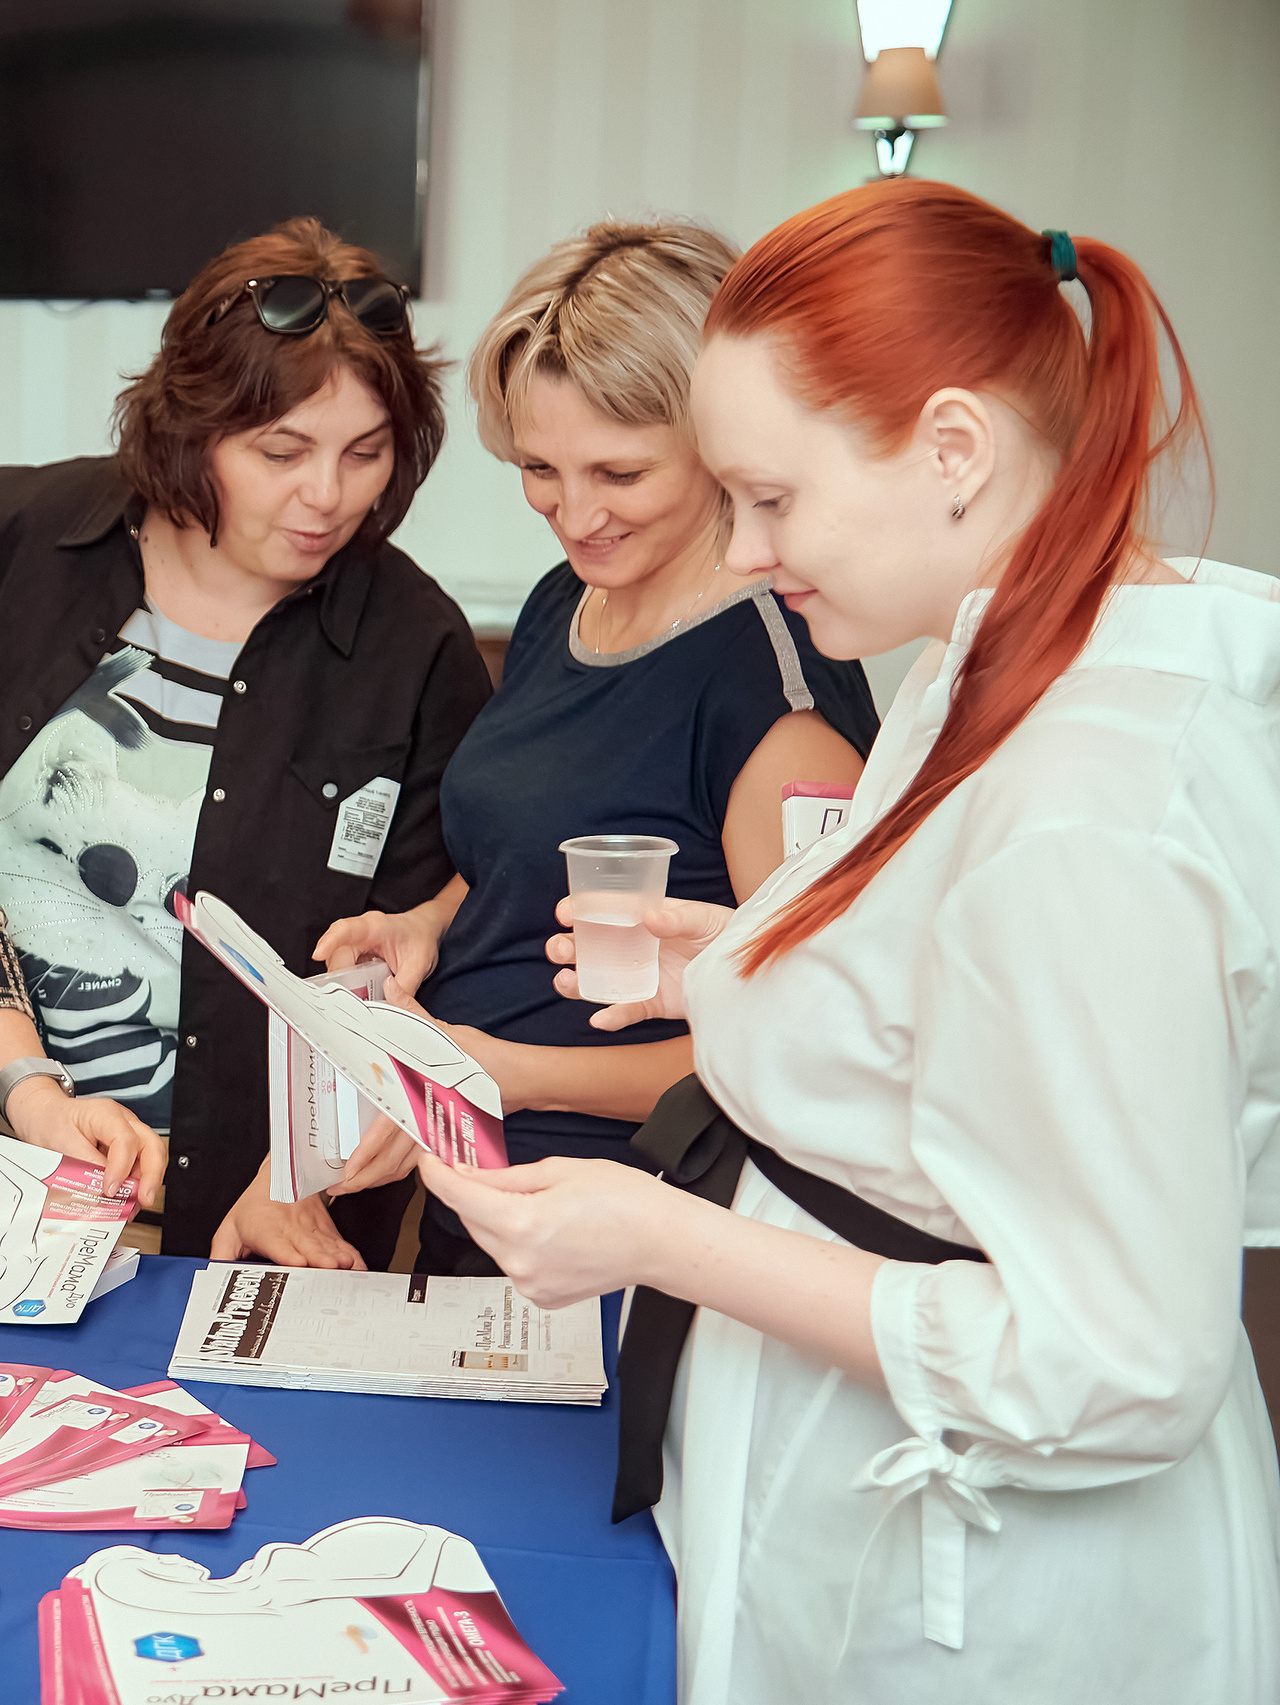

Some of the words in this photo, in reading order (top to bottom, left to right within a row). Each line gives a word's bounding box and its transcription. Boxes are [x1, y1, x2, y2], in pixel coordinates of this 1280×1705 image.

[60, 1228, 109, 1294] ПреМама
[65, 1291, 86, 1309] Дуо
[453, 1611, 487, 1648] ОМЕГА-3
[201, 1677, 412, 1699] ПреМама
